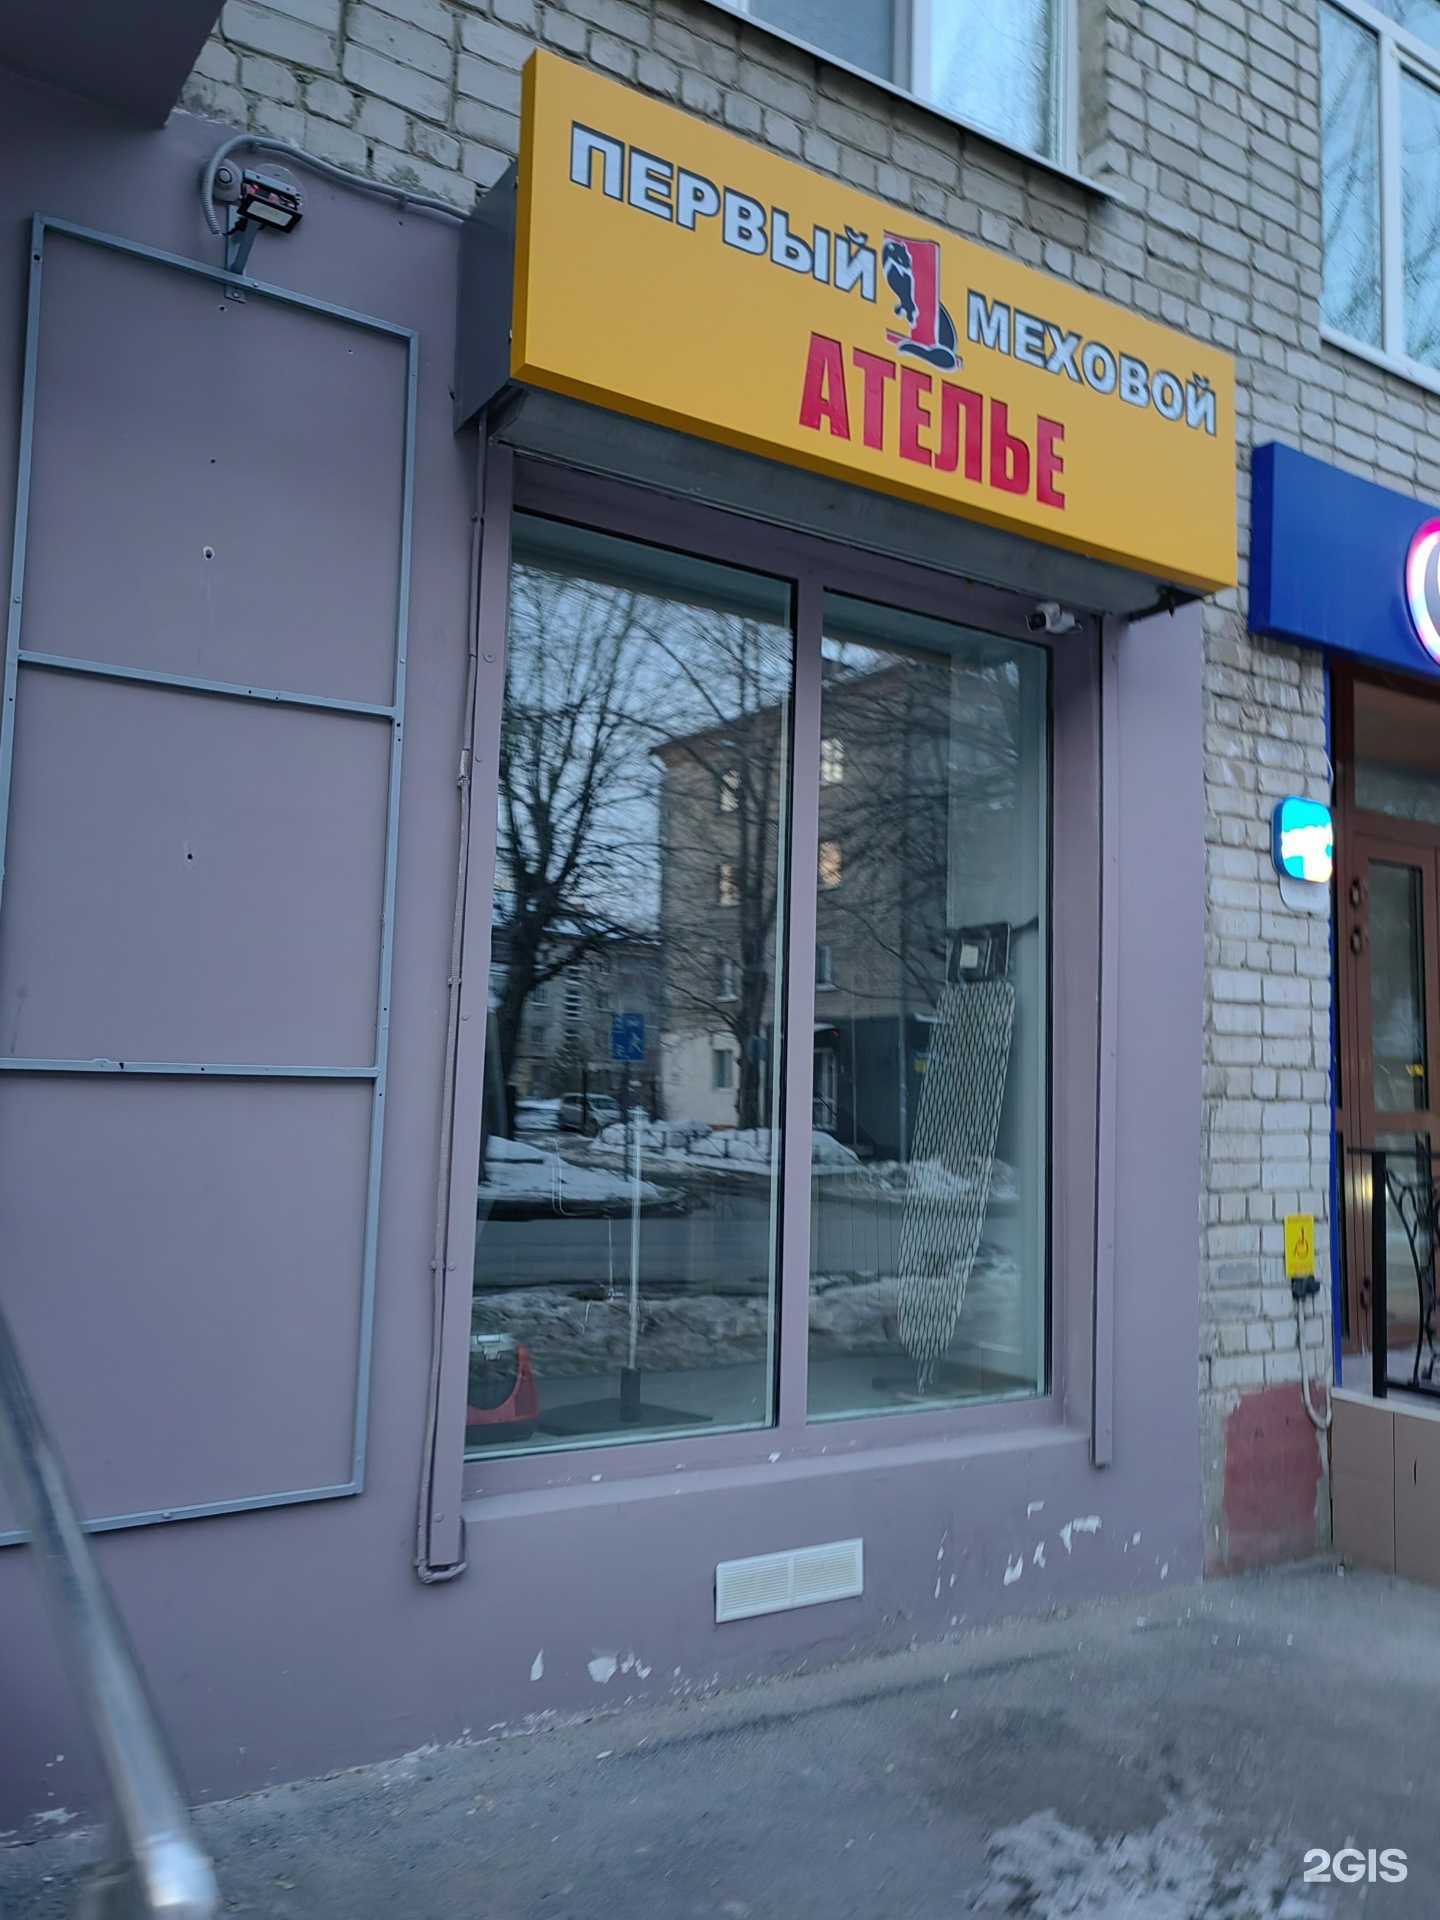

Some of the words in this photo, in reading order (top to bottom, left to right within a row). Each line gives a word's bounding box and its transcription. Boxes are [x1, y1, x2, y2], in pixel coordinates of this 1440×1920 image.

[570, 121, 877, 302] ПЕРВЫЙ
[967, 289, 1217, 436] МЕХОВОЙ
[799, 332, 1065, 510] АТЕЛЬЕ
